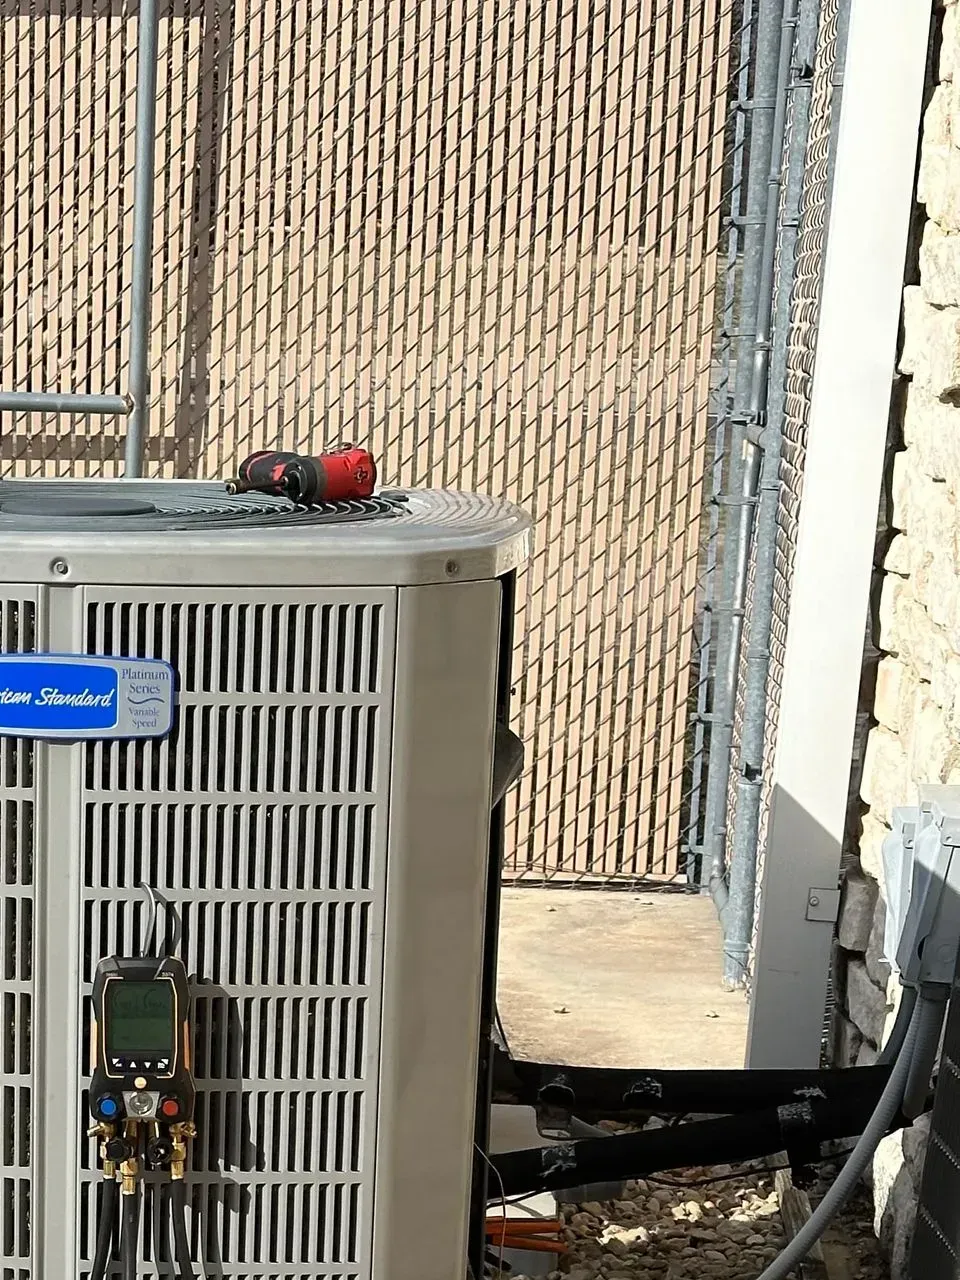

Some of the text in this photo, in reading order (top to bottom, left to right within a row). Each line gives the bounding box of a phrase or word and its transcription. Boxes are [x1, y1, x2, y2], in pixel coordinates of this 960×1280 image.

[121, 668, 169, 681] Platinum
[129, 683, 161, 694] Series
[35, 687, 115, 707] Standard
[128, 707, 160, 717] Variable
[132, 719, 157, 729] Speed
